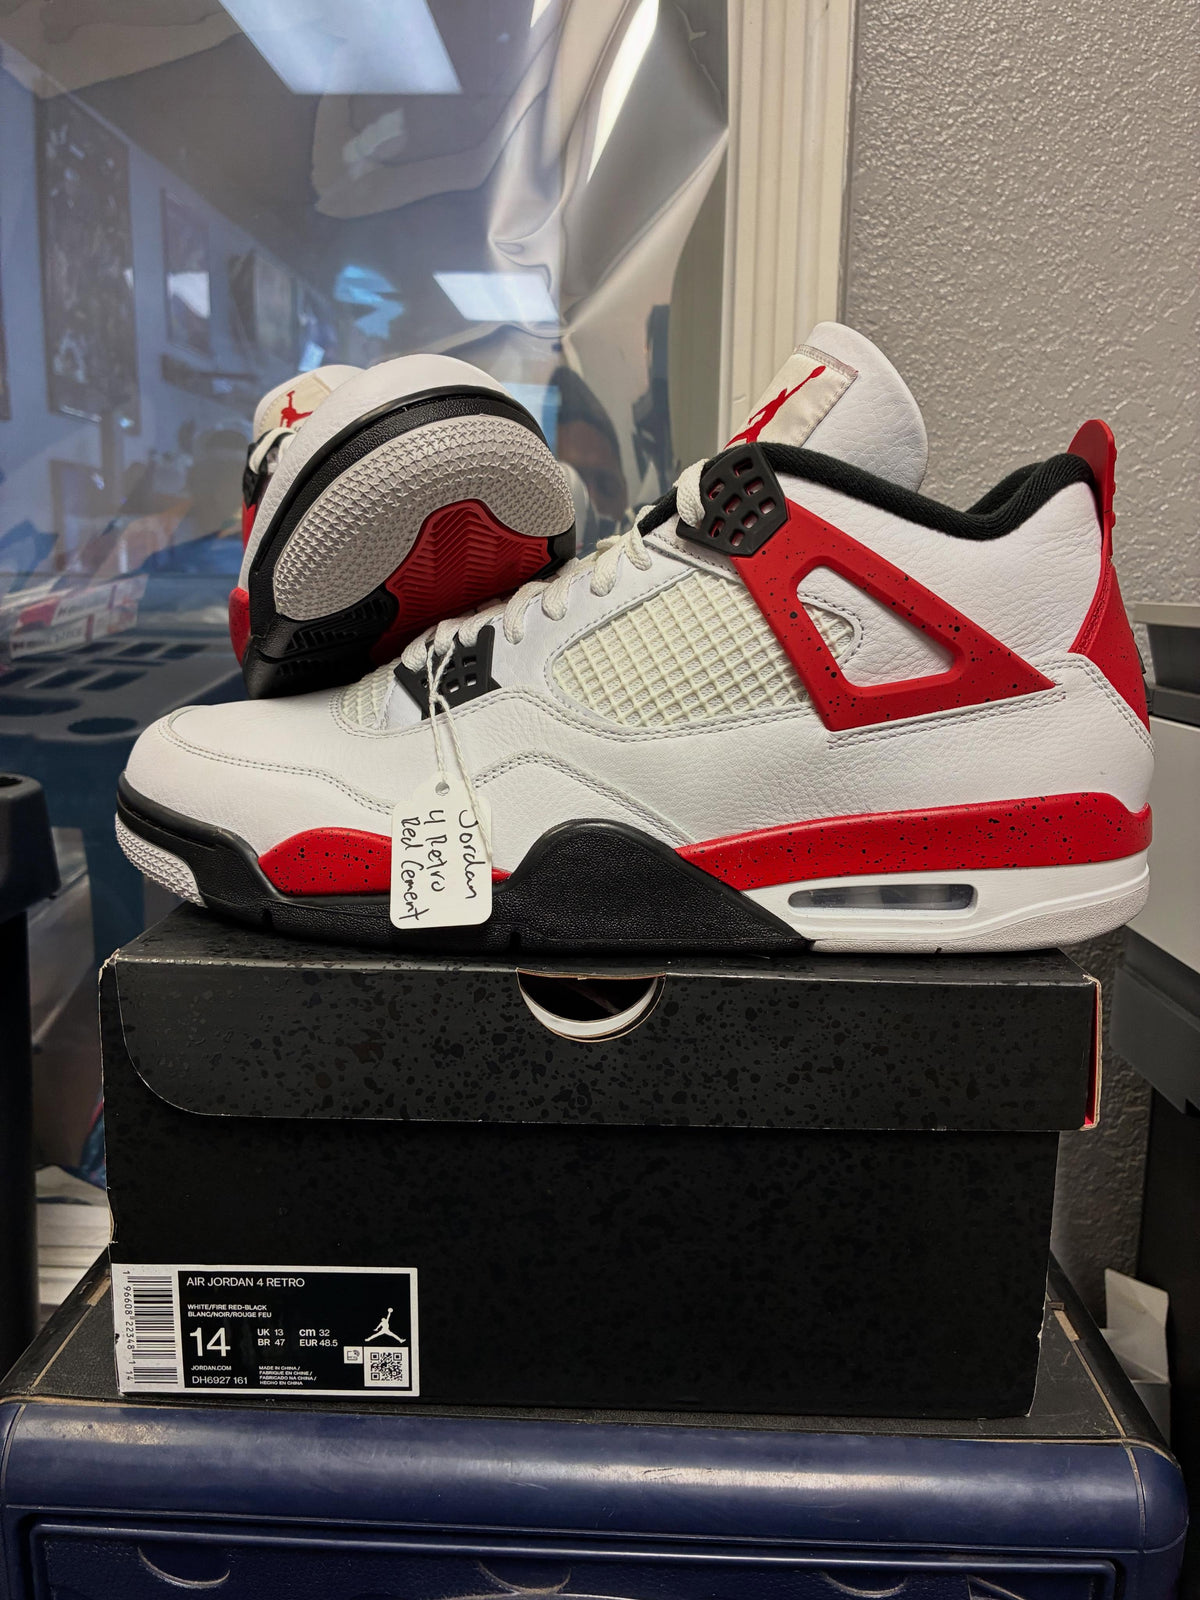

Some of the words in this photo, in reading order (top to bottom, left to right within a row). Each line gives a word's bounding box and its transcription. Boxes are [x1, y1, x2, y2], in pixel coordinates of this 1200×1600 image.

[424, 810, 446, 825] 4
[401, 816, 424, 850] Red
[425, 834, 447, 892] Retro
[458, 809, 486, 899] Jordan
[399, 860, 430, 921] Cement
[186, 1277, 205, 1286] AIR
[207, 1277, 254, 1287] JORDAN
[256, 1277, 264, 1287] 4
[266, 1277, 305, 1287] RETRO
[123, 1286, 133, 1315] 96608
[125, 1321, 135, 1350] 22348
[189, 1327, 231, 1357] 14
[257, 1328, 270, 1336] UK
[274, 1328, 284, 1336] 13
[298, 1328, 316, 1337] cm
[318, 1329, 330, 1337] 32
[257, 1338, 270, 1346] BR
[274, 1338, 285, 1346] 47
[299, 1339, 318, 1347] EUR
[319, 1339, 338, 1347] 48.5
[191, 1376, 230, 1384] DH6927
[233, 1376, 248, 1385] 161
